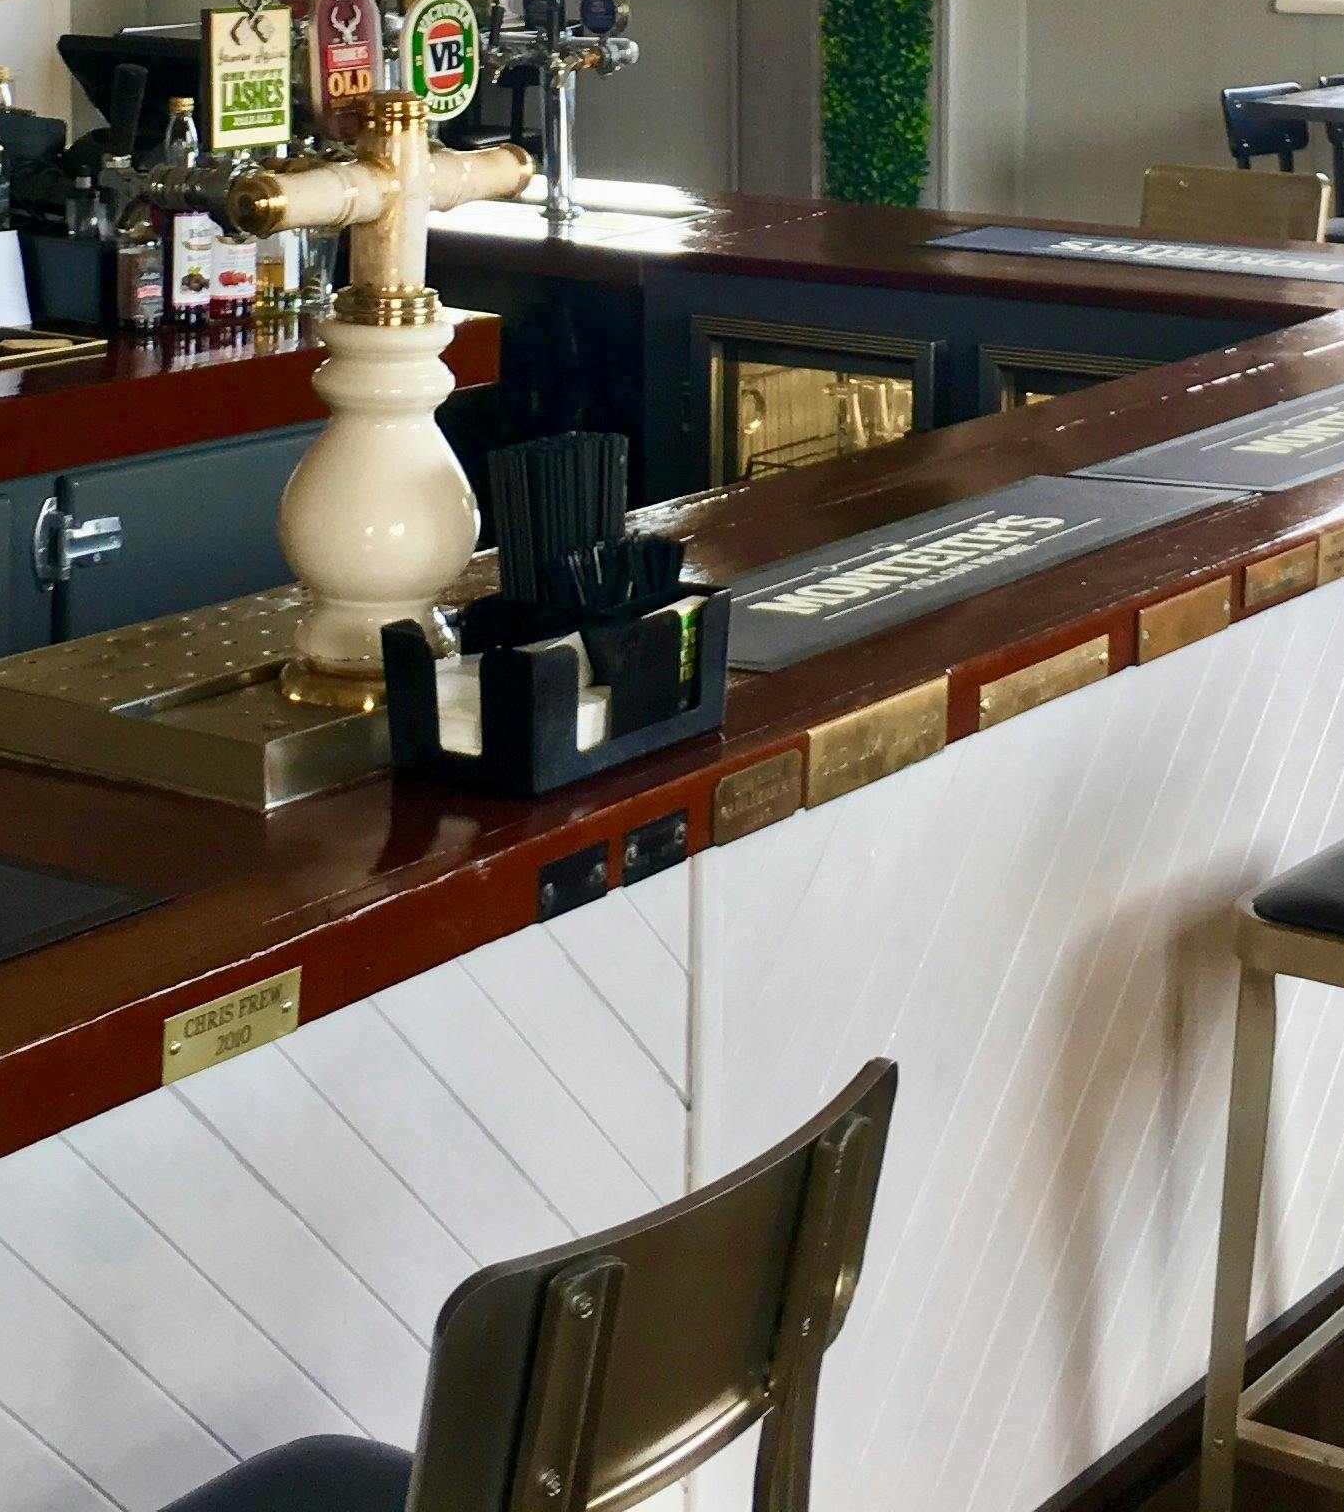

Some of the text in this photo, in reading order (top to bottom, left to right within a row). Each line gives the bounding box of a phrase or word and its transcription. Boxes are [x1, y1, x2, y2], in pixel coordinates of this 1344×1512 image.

[429, 39, 465, 72] VB
[327, 69, 373, 98] OLD
[747, 514, 1065, 614] MONTEITH'S
[183, 1002, 235, 1038] CHRIS
